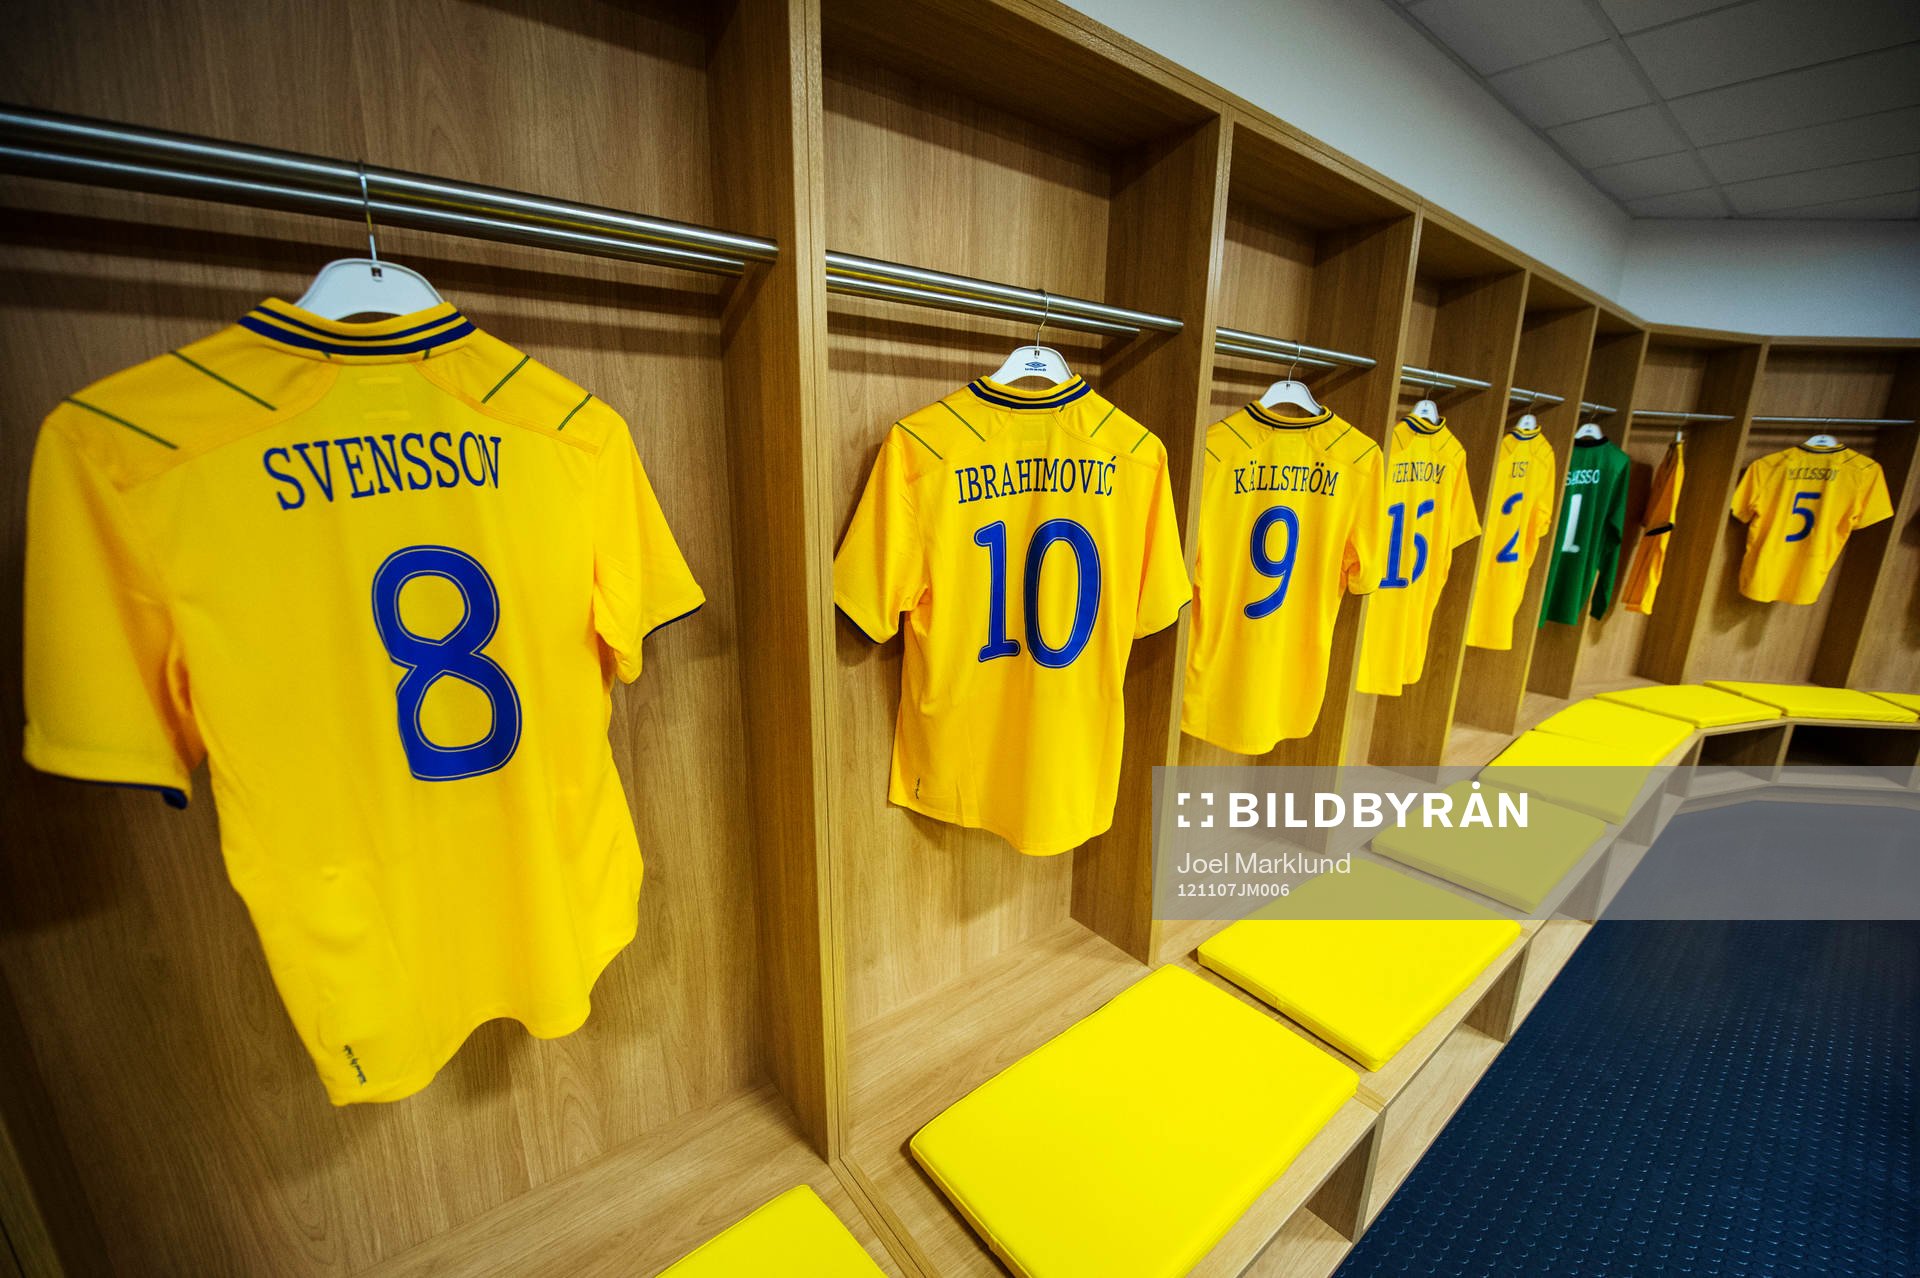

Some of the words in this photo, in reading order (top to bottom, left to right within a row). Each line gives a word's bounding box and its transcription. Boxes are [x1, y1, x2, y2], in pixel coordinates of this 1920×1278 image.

[263, 431, 502, 511] SVENSSON
[955, 456, 1117, 504] IBRAHIMOVIĆ
[1233, 460, 1339, 497] KÄLLSTRÖM
[1561, 493, 1583, 553] 1
[1785, 491, 1822, 542] 5
[974, 518, 1101, 669] 10
[1244, 505, 1300, 619] 9
[371, 545, 522, 782] 8
